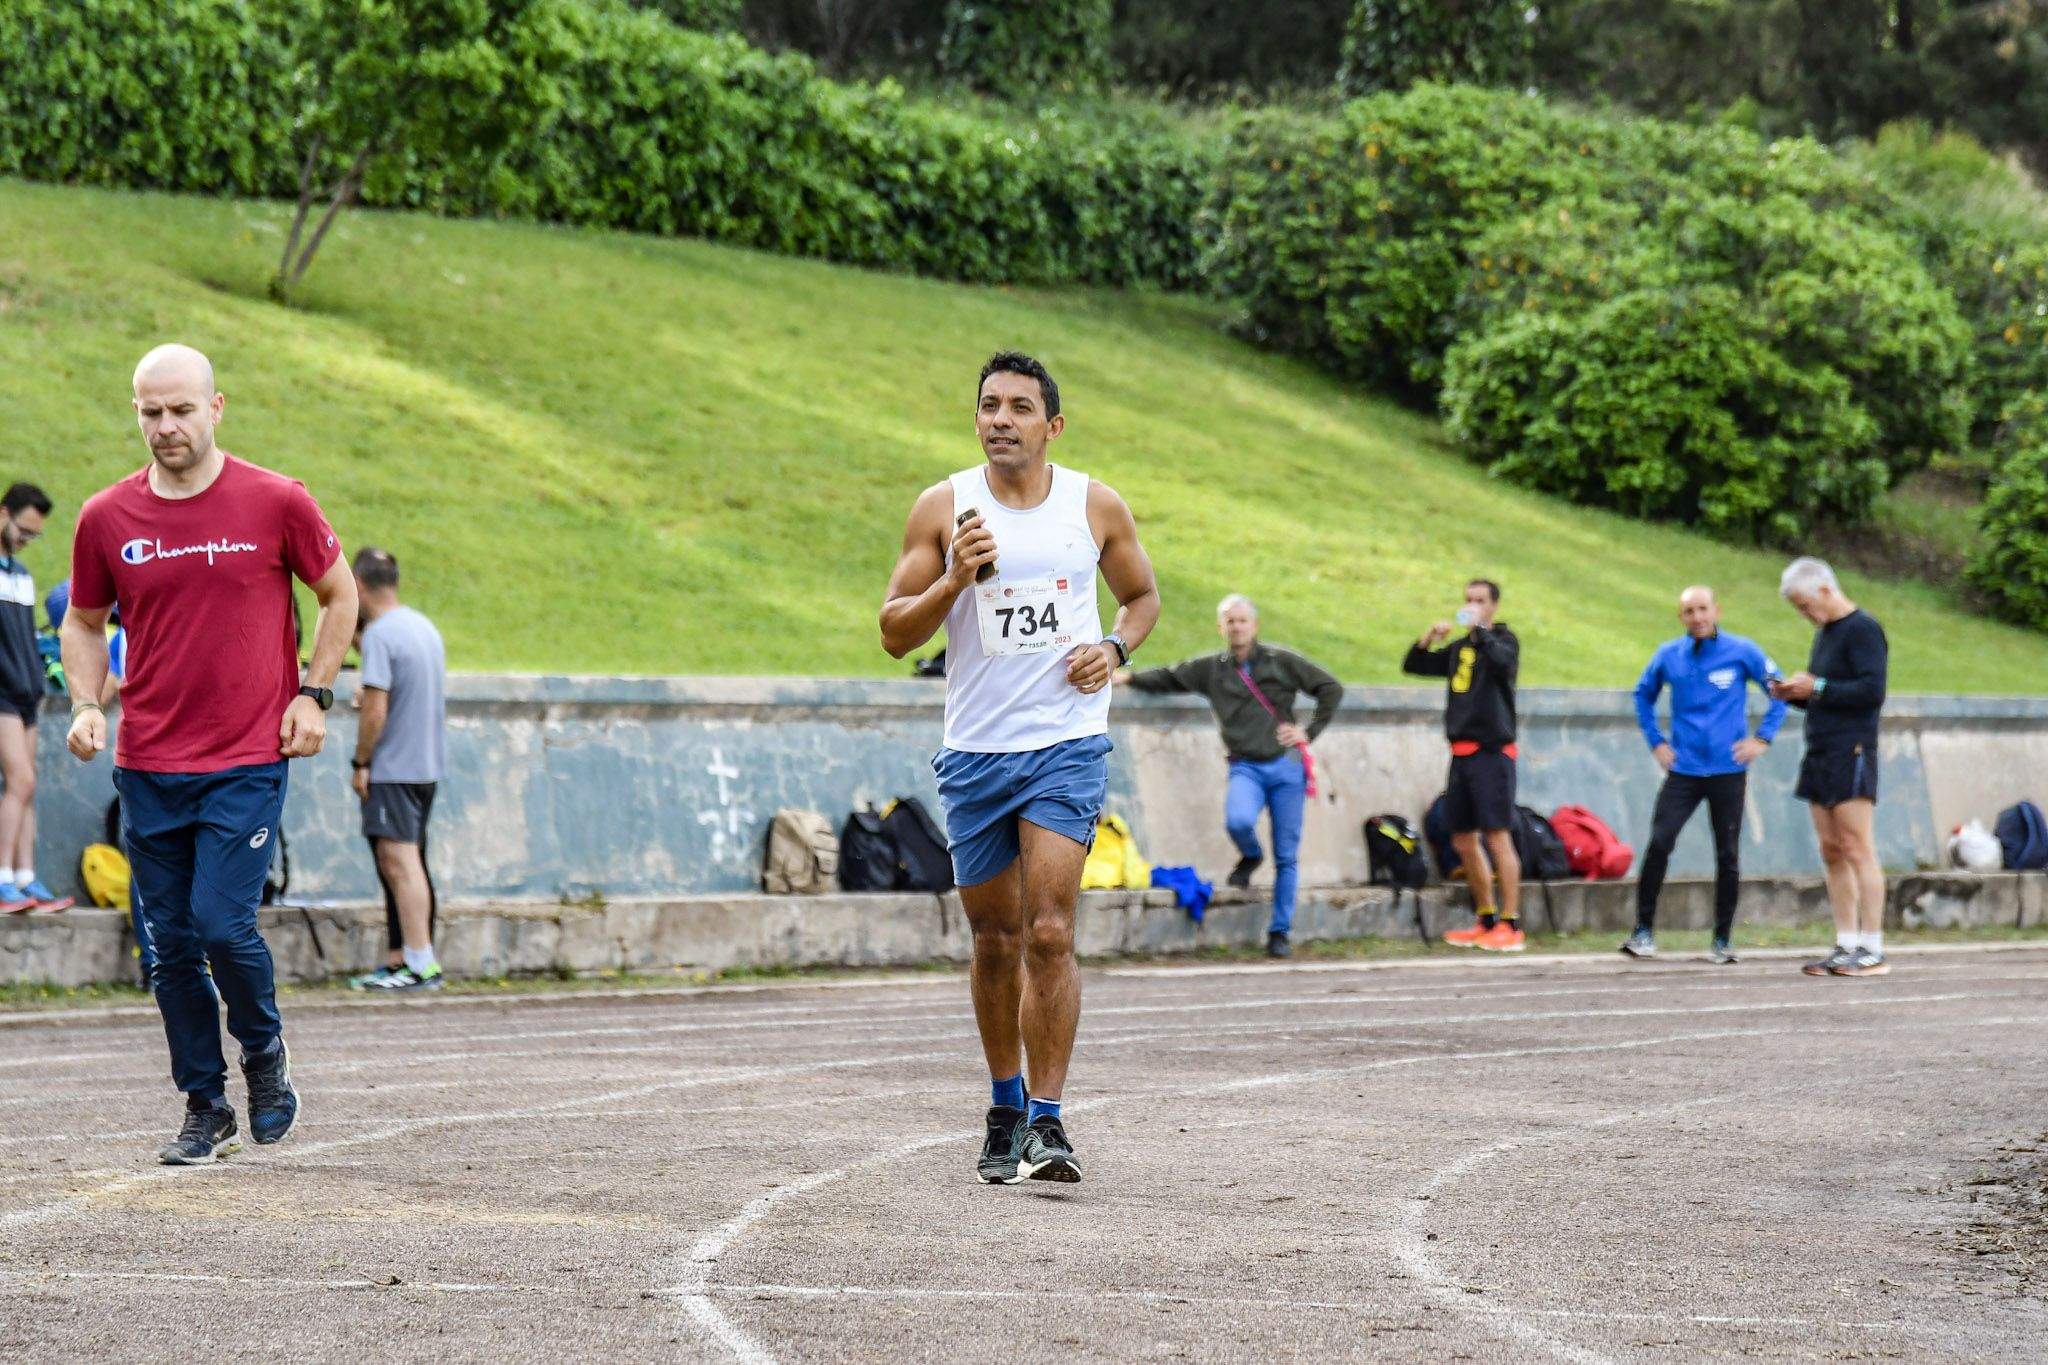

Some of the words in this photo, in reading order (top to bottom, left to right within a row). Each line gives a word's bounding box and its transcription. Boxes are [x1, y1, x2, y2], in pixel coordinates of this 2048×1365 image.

[121, 538, 257, 566] Champion
[995, 602, 1059, 638] 734
[1054, 635, 1072, 645] 2023
